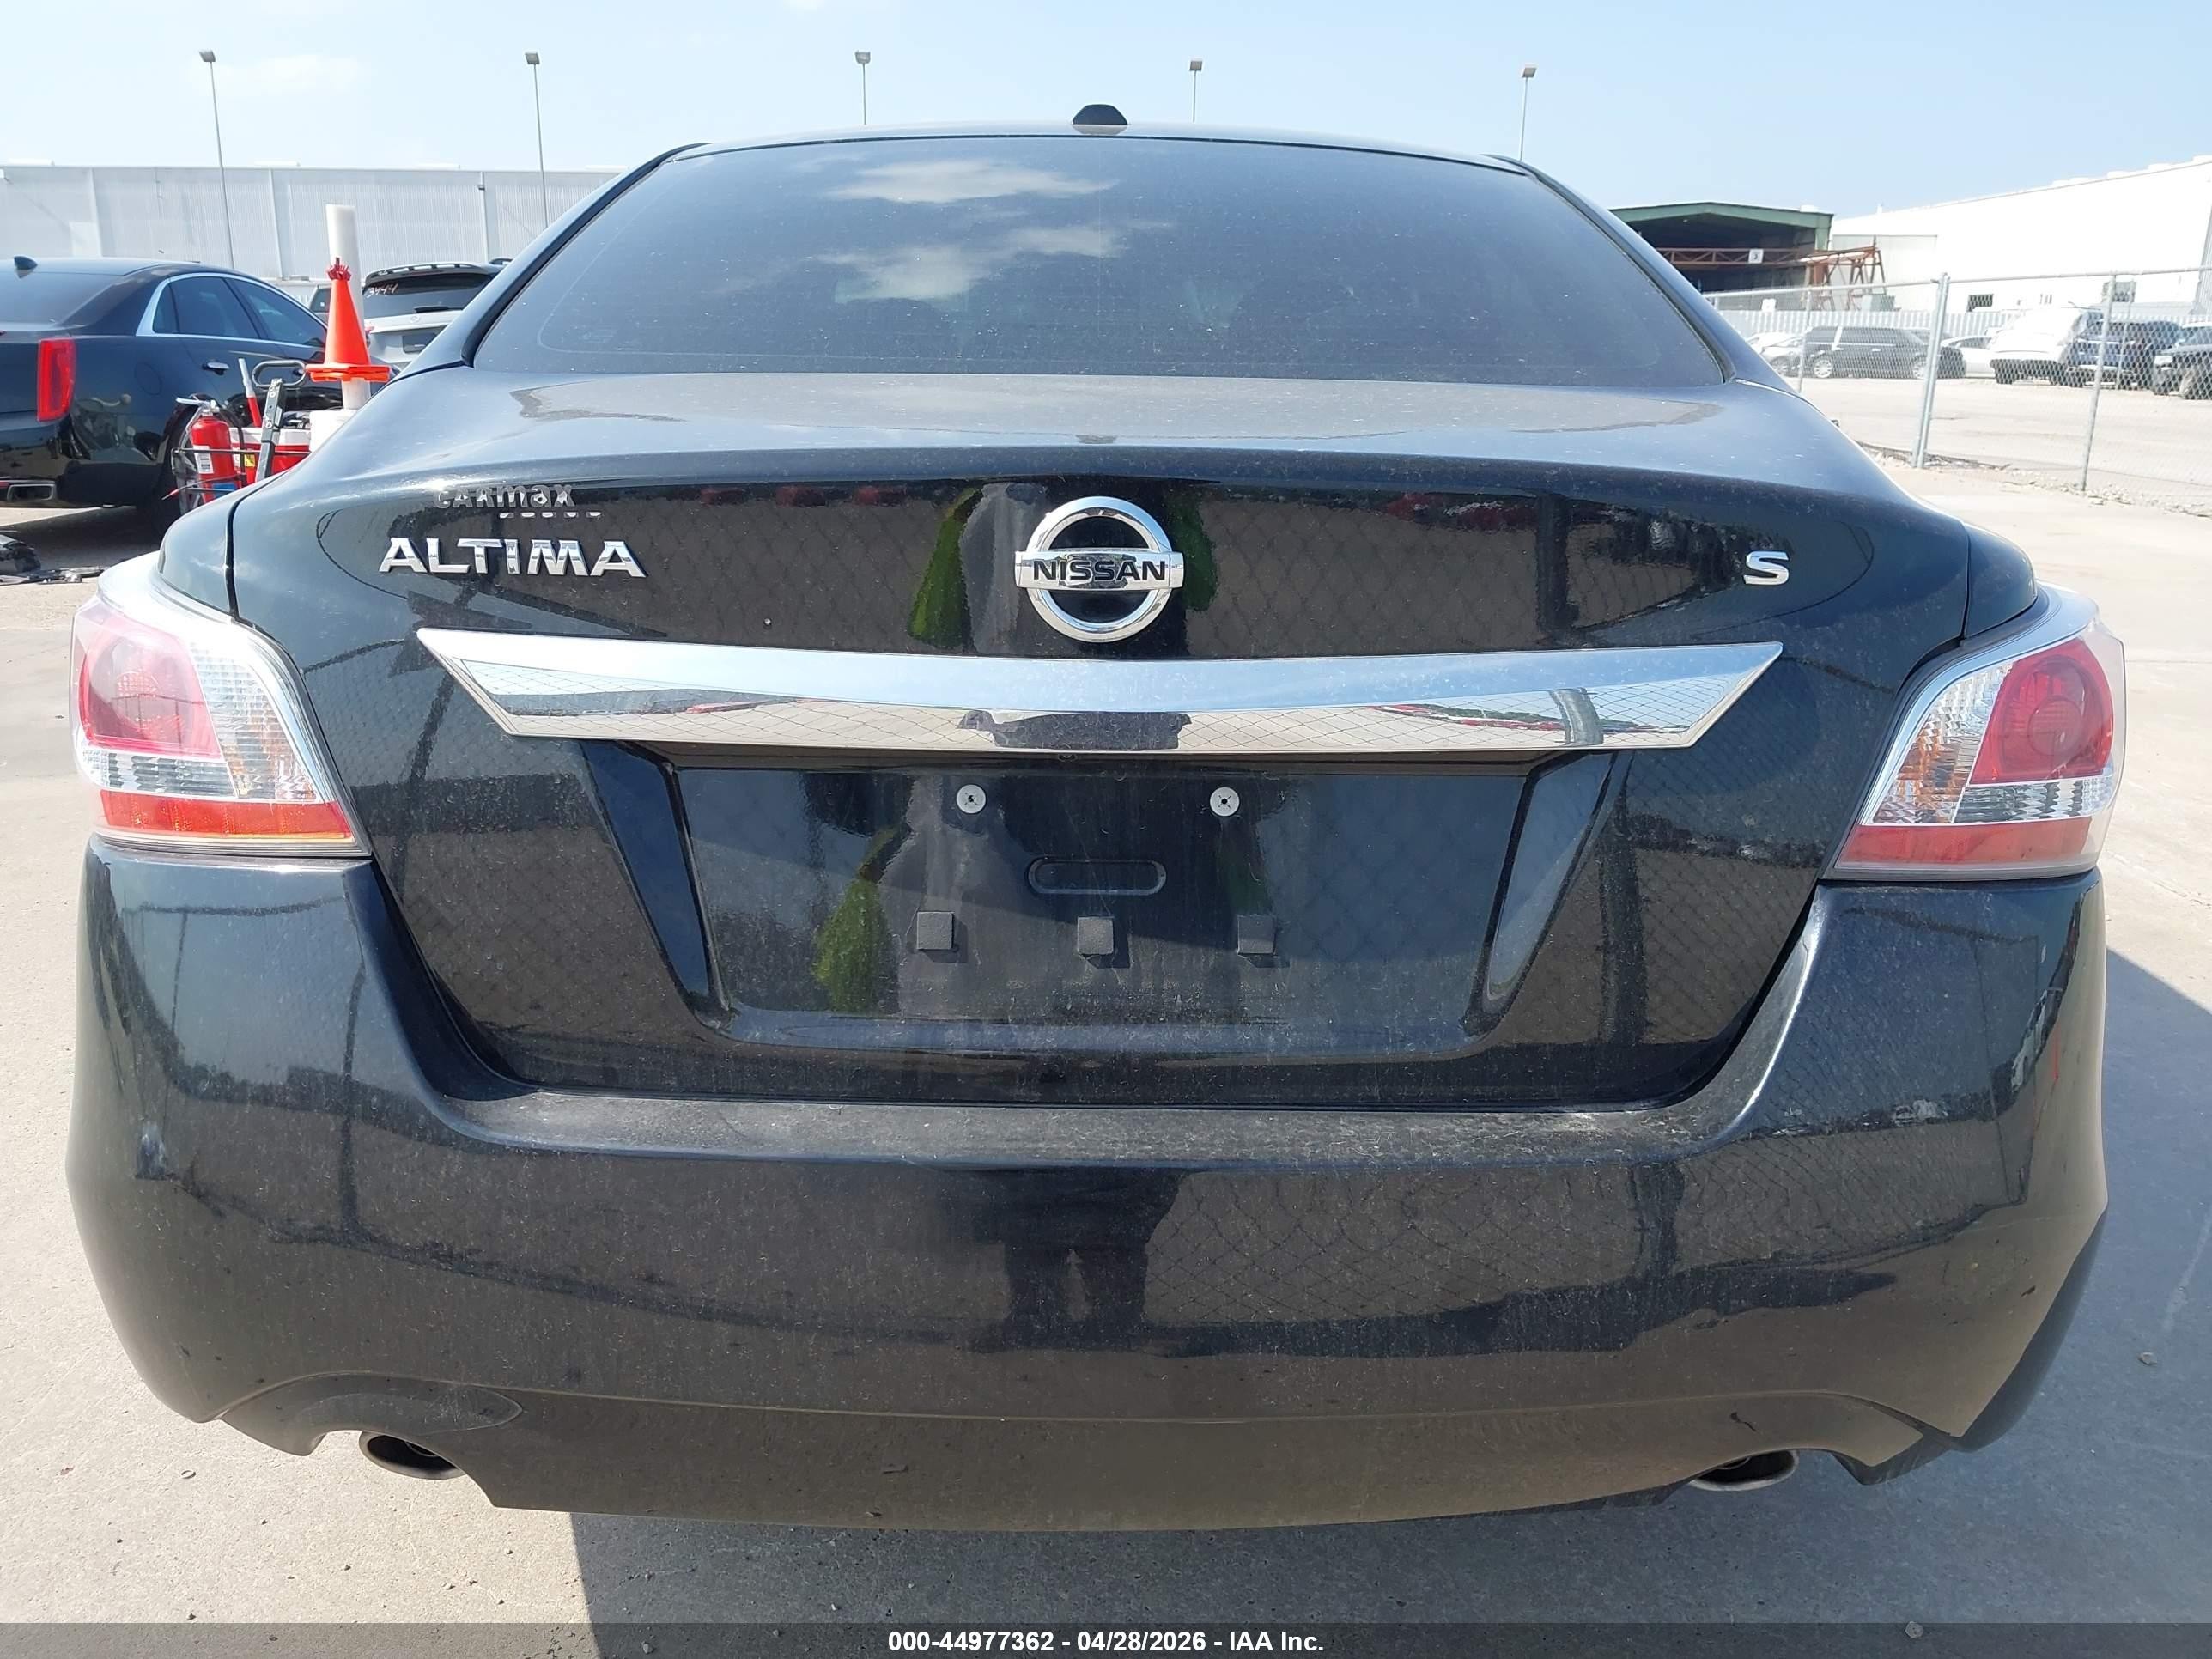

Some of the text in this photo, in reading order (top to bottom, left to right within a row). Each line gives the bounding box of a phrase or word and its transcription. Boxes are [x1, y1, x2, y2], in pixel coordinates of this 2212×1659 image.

[379, 538, 647, 578] ALTIMA
[1033, 560, 1165, 580] NISSAN
[1743, 550, 1790, 586] S
